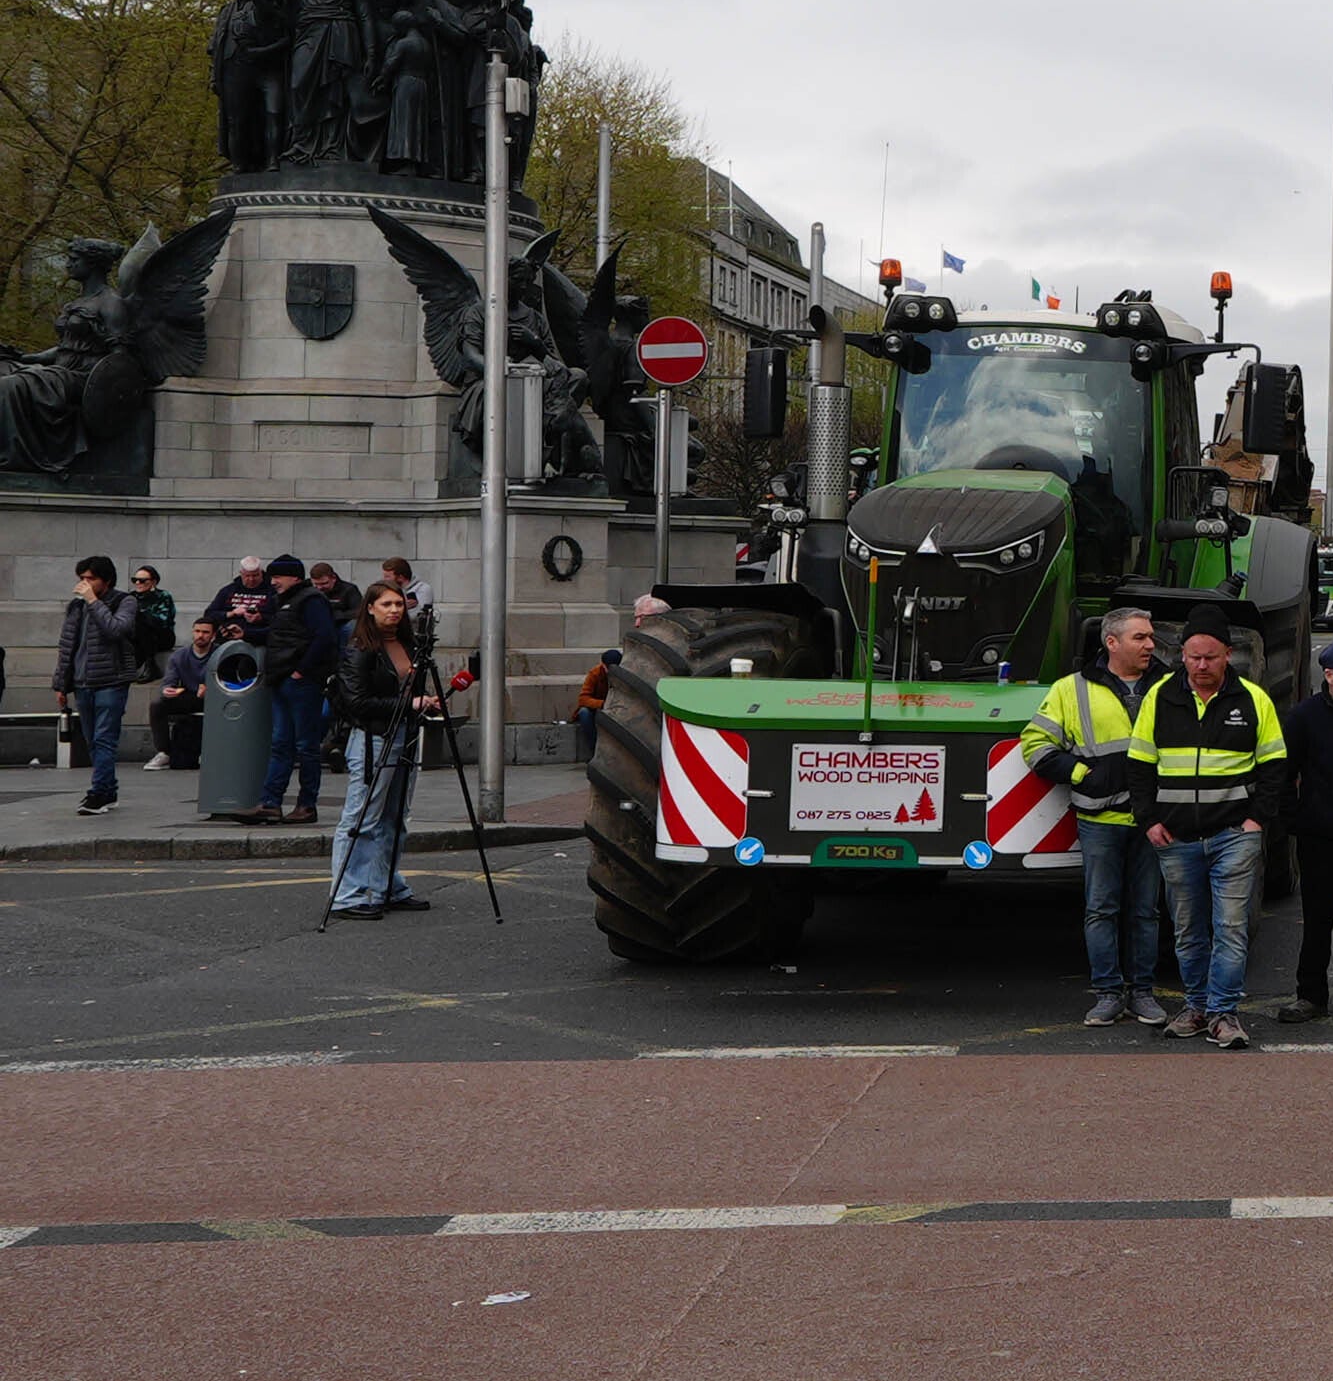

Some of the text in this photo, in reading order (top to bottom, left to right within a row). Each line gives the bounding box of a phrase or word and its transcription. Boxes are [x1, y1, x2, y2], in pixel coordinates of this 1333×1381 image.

[967, 332, 1087, 354] CHAMBERS
[893, 596, 967, 611] NDT
[799, 751, 940, 769] CHAMBERS
[798, 770, 940, 784] WOOD CHIPPING
[796, 810, 893, 820] 087 275 0825
[834, 846, 897, 860] 700 Kg
